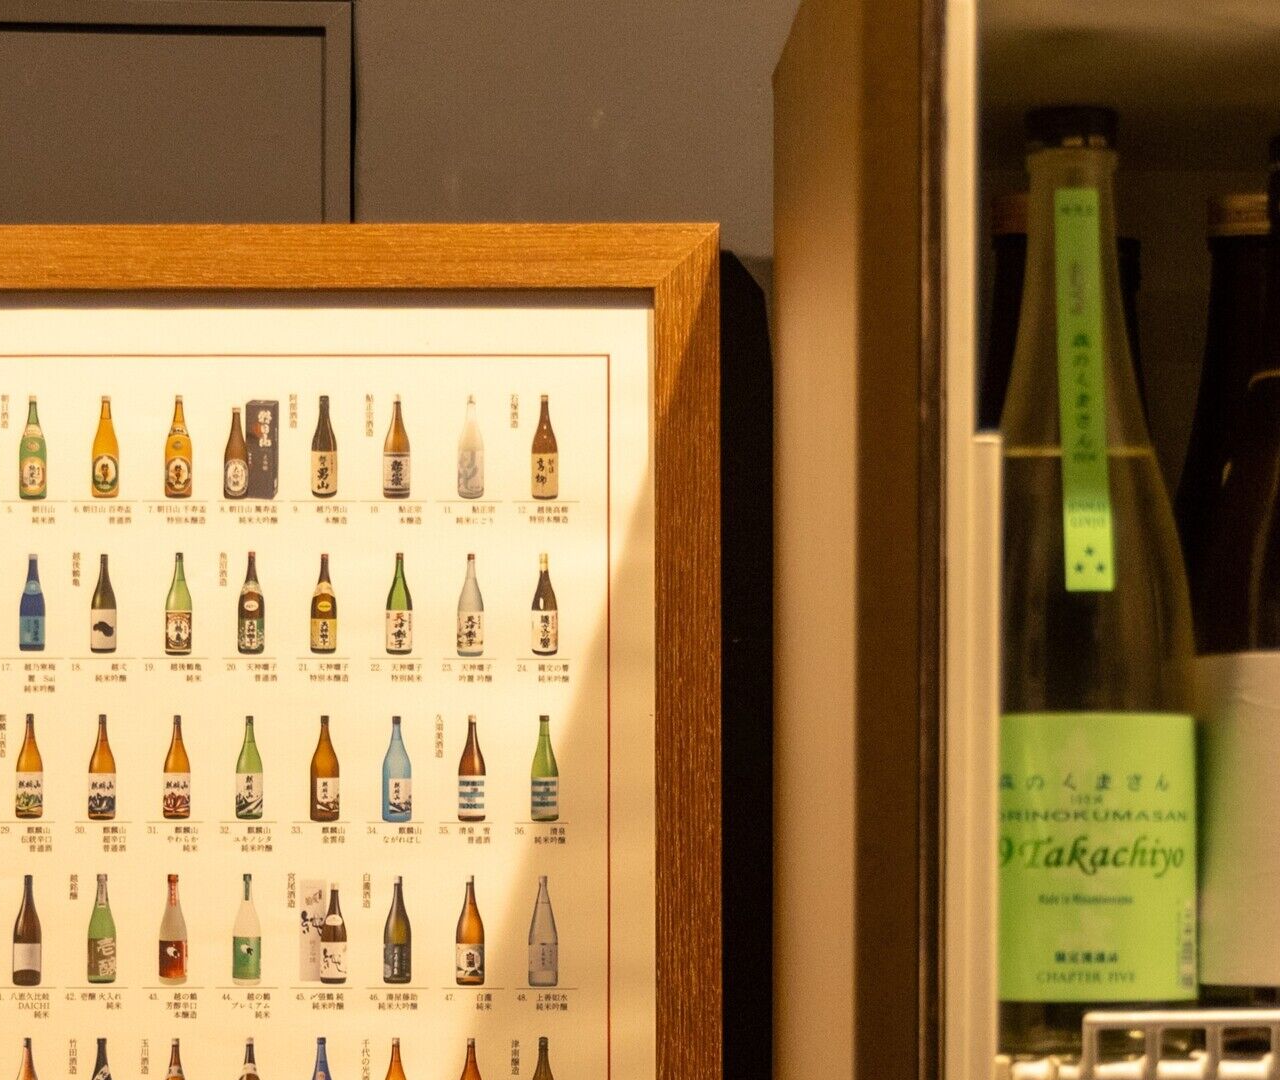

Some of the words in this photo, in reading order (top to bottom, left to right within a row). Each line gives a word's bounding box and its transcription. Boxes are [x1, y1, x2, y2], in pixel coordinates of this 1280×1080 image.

[1021, 834, 1184, 877] Takachiyo
[17, 1001, 51, 1011] DAICHI
[535, 1000, 568, 1012] 純米吟醸
